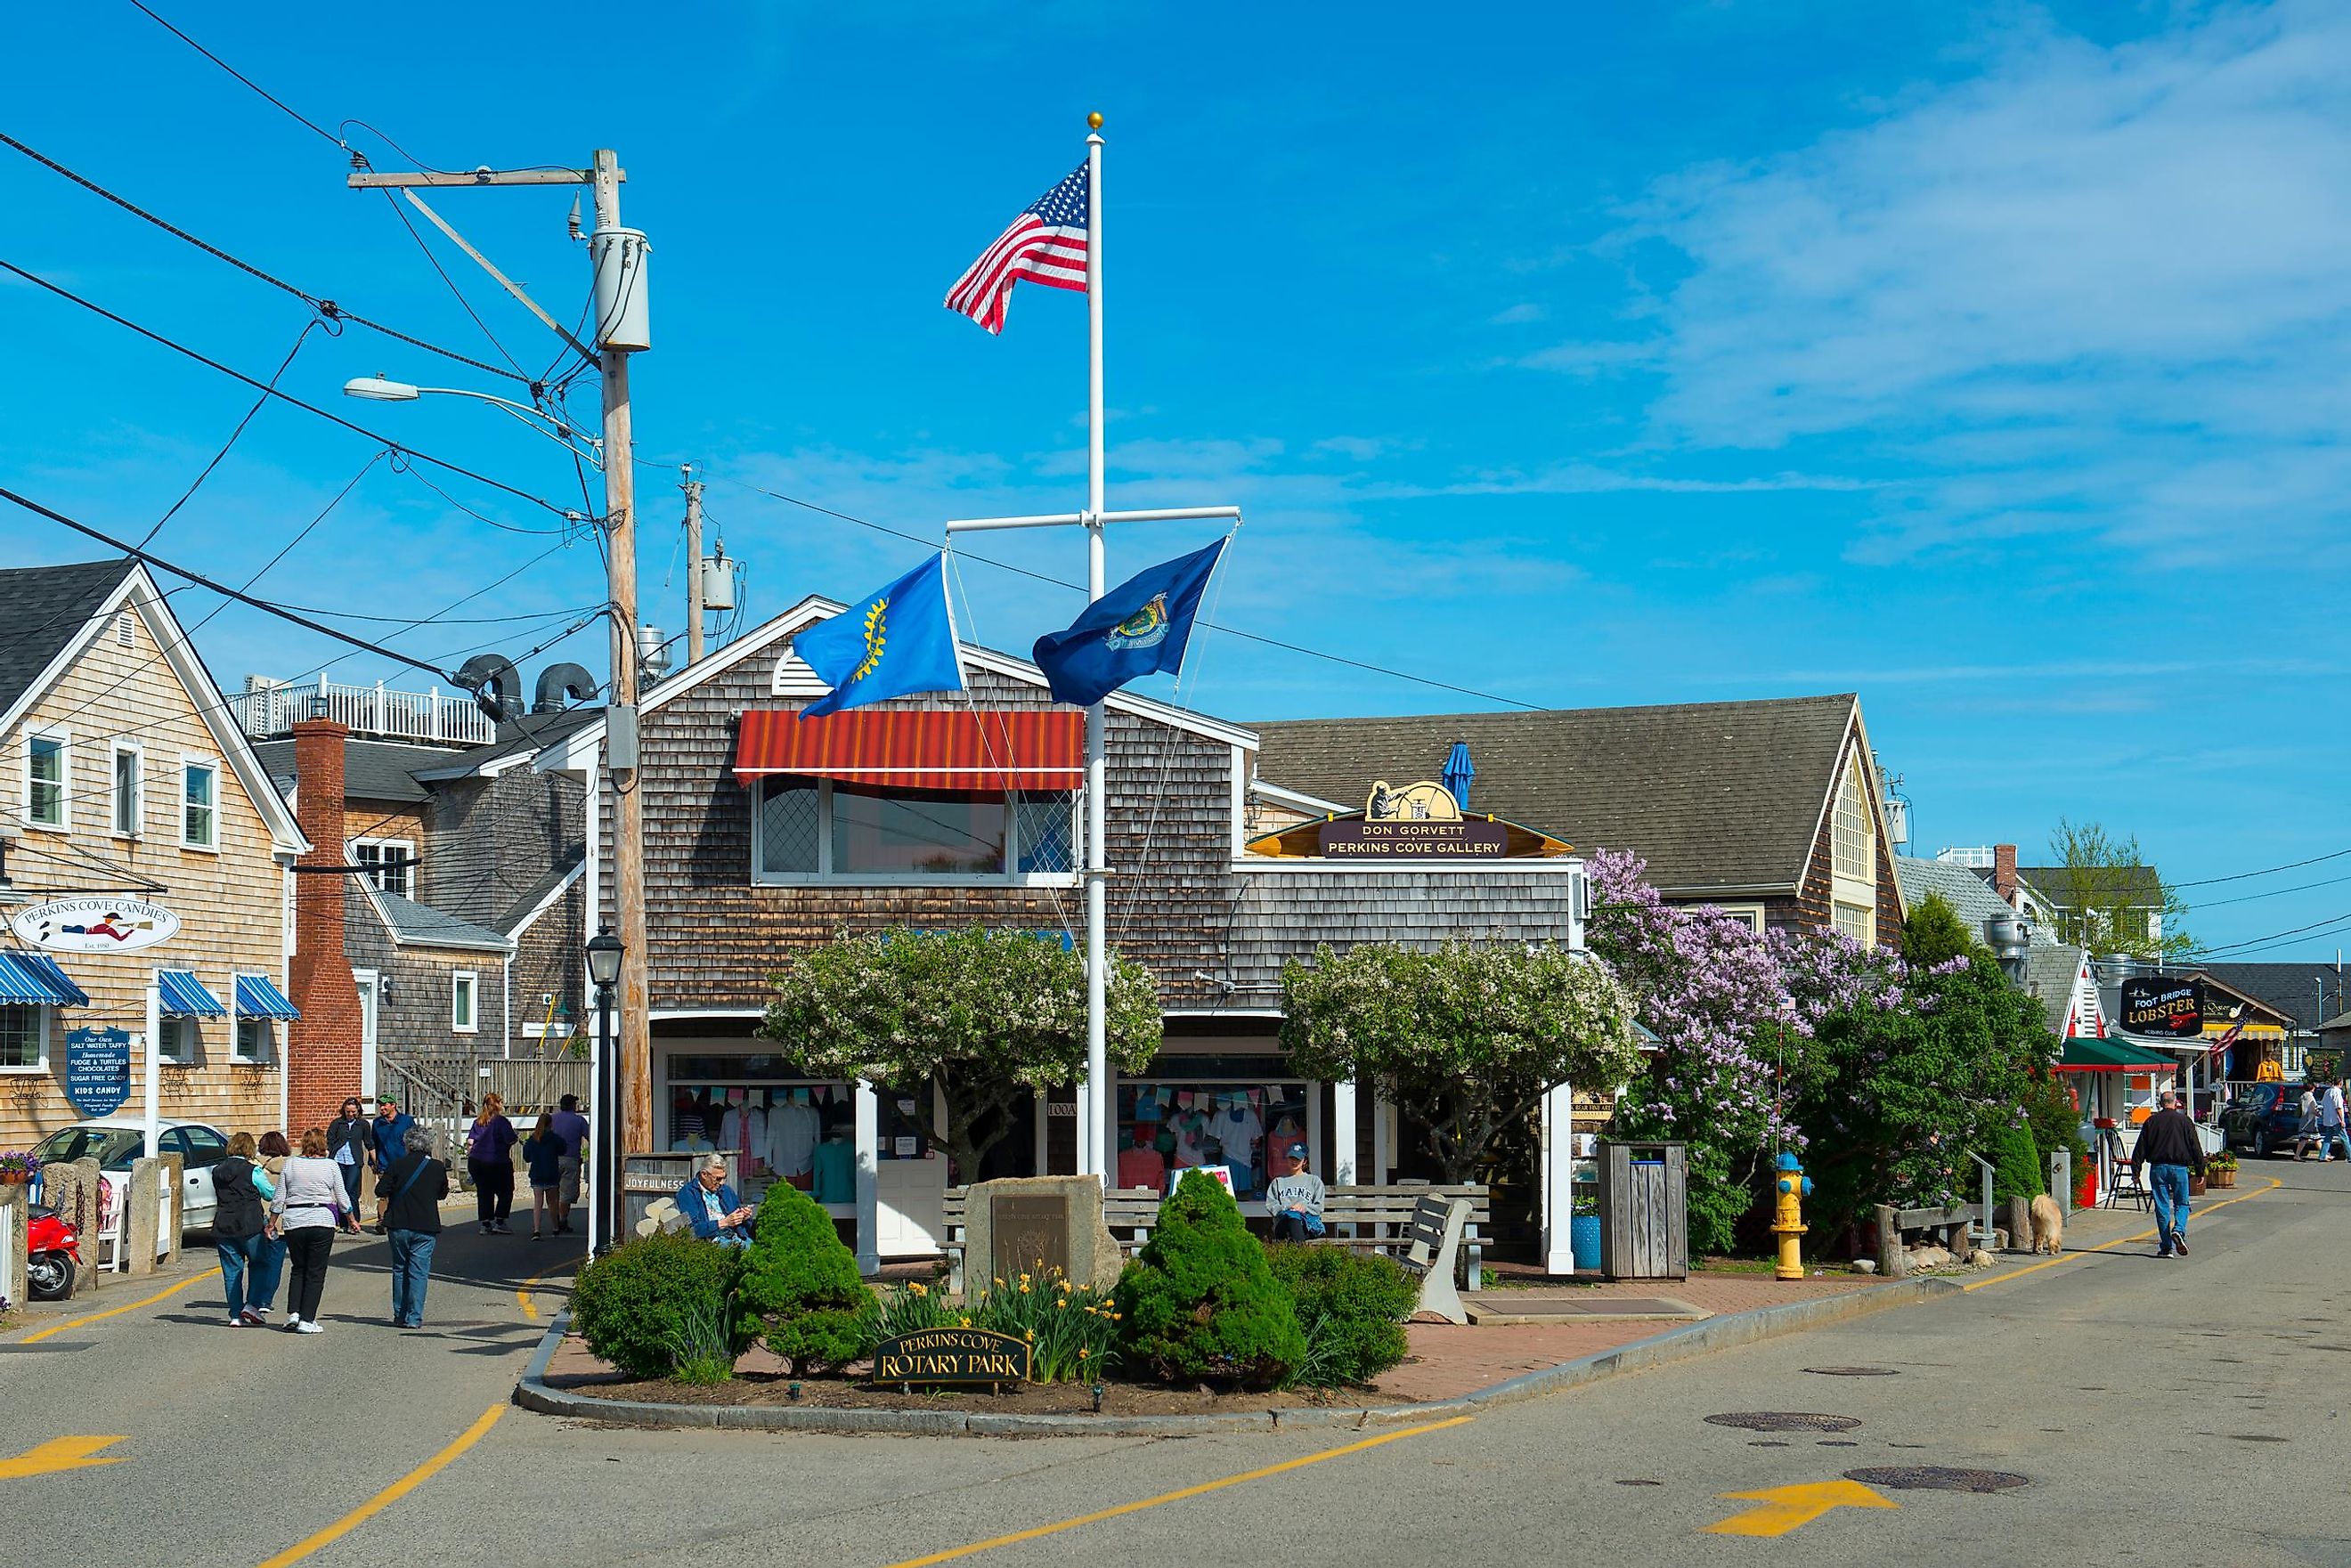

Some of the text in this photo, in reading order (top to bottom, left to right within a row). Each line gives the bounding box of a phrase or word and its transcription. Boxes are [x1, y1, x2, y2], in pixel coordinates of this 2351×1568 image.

[1363, 825, 1465, 835] DON GORVETT
[1329, 842, 1501, 853] PERKINS COVE GALLERY
[24, 901, 169, 924] PERKINS COVE CANDIES
[2135, 988, 2192, 1008] FOOT BRIDGE
[2128, 998, 2195, 1024] LOBSTER
[74, 1086, 121, 1095] KIDS CANDY
[625, 1178, 685, 1190] JOYFULNESS
[1278, 1187, 1312, 1201] MAINE
[899, 1333, 1004, 1354] PERKINS COVE
[882, 1354, 1020, 1377] ROTARY PARK
